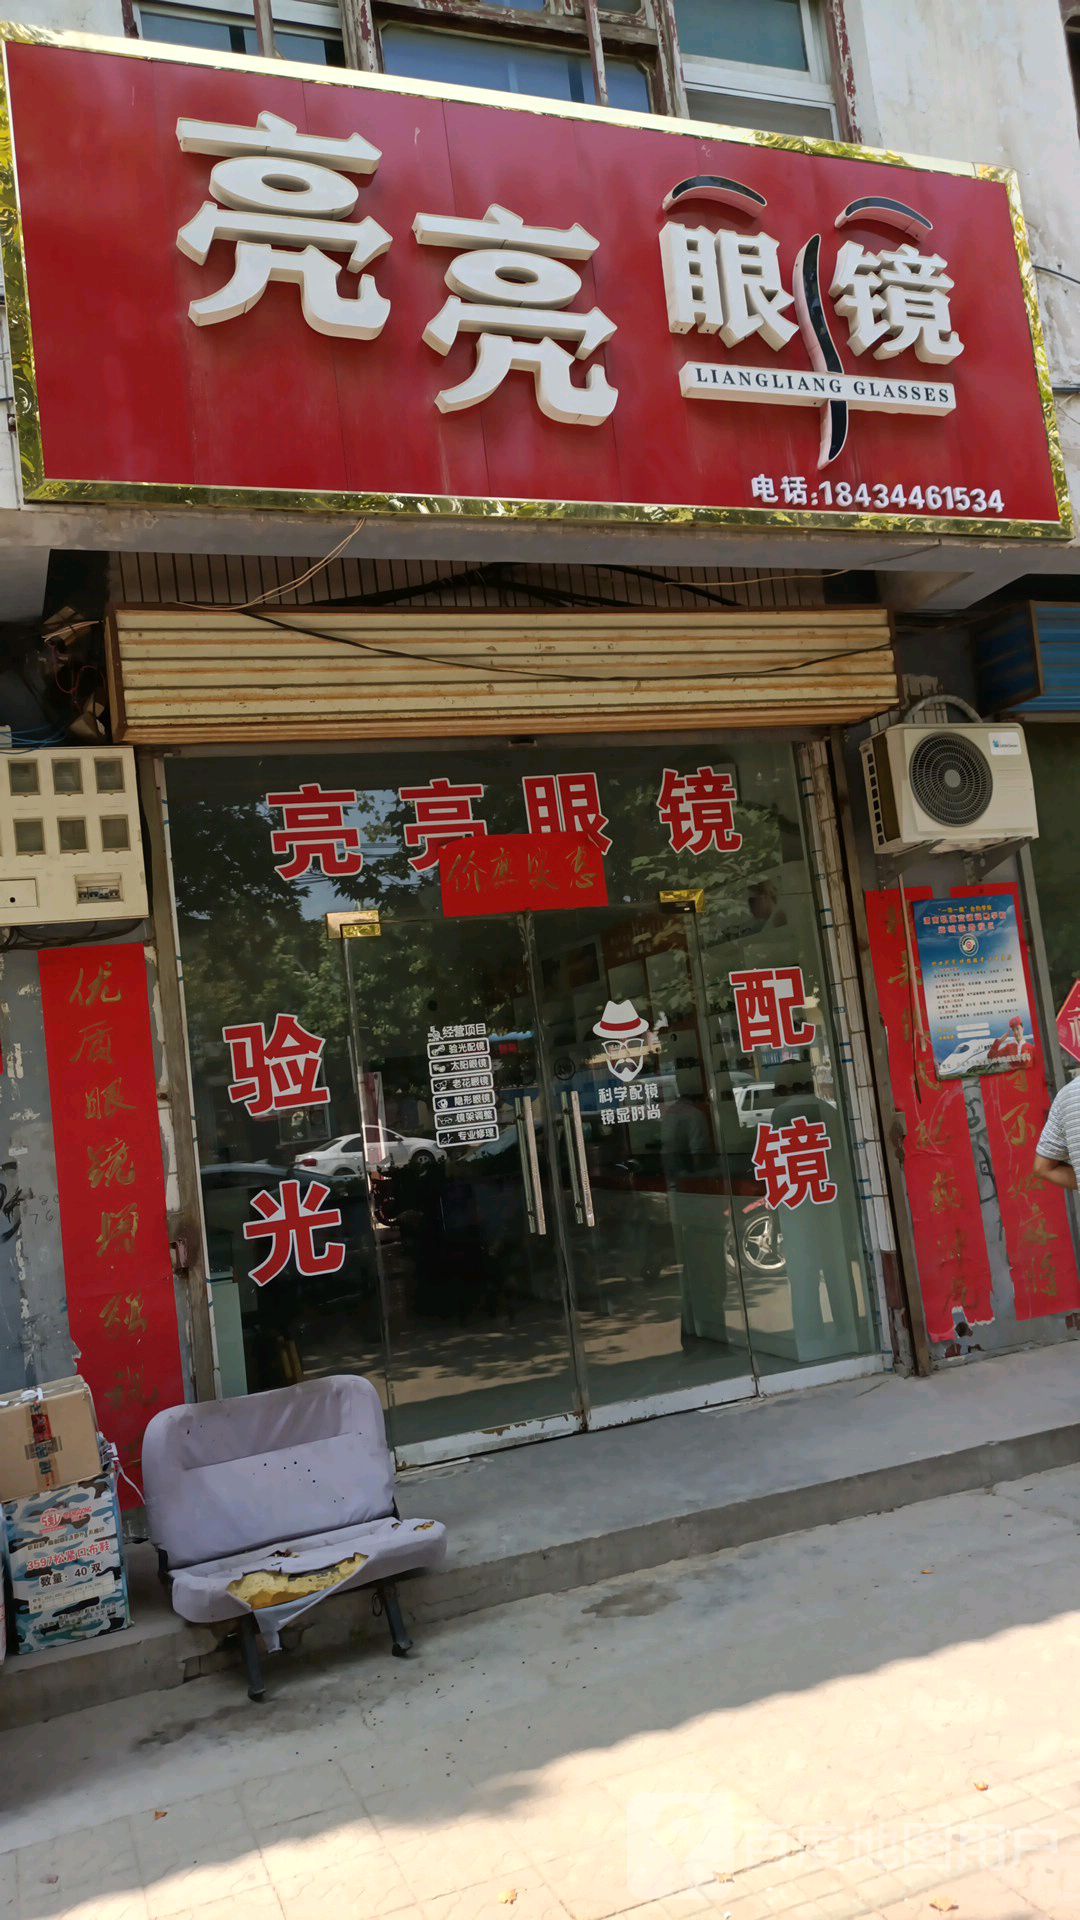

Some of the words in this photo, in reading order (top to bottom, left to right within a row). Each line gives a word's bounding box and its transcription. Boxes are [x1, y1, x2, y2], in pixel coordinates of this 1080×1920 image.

[176, 111, 965, 427] 亮亮眼镜
[696, 368, 842, 394] LIANGLIANG
[853, 381, 949, 404] GLASSES
[751, 474, 1005, 513] 电话:18434461534
[266, 766, 743, 881] 亮亮眼镜
[442, 1023, 486, 1039] 经营项目
[448, 1041, 486, 1054] 验光配镜
[450, 1058, 488, 1071] 太阳眼镜
[452, 1076, 489, 1089] 老花眼镜
[728, 966, 838, 1211] 配镜
[454, 1093, 491, 1106] 隐形眼镜
[598, 1083, 659, 1104] 科学配镜
[600, 1104, 661, 1126] 镜显时尚
[457, 1127, 495, 1141] 专业修理
[222, 1013, 345, 1287] 验光
[74, 1566, 88, 1578] 40
[90, 1562, 102, 1574] 双
